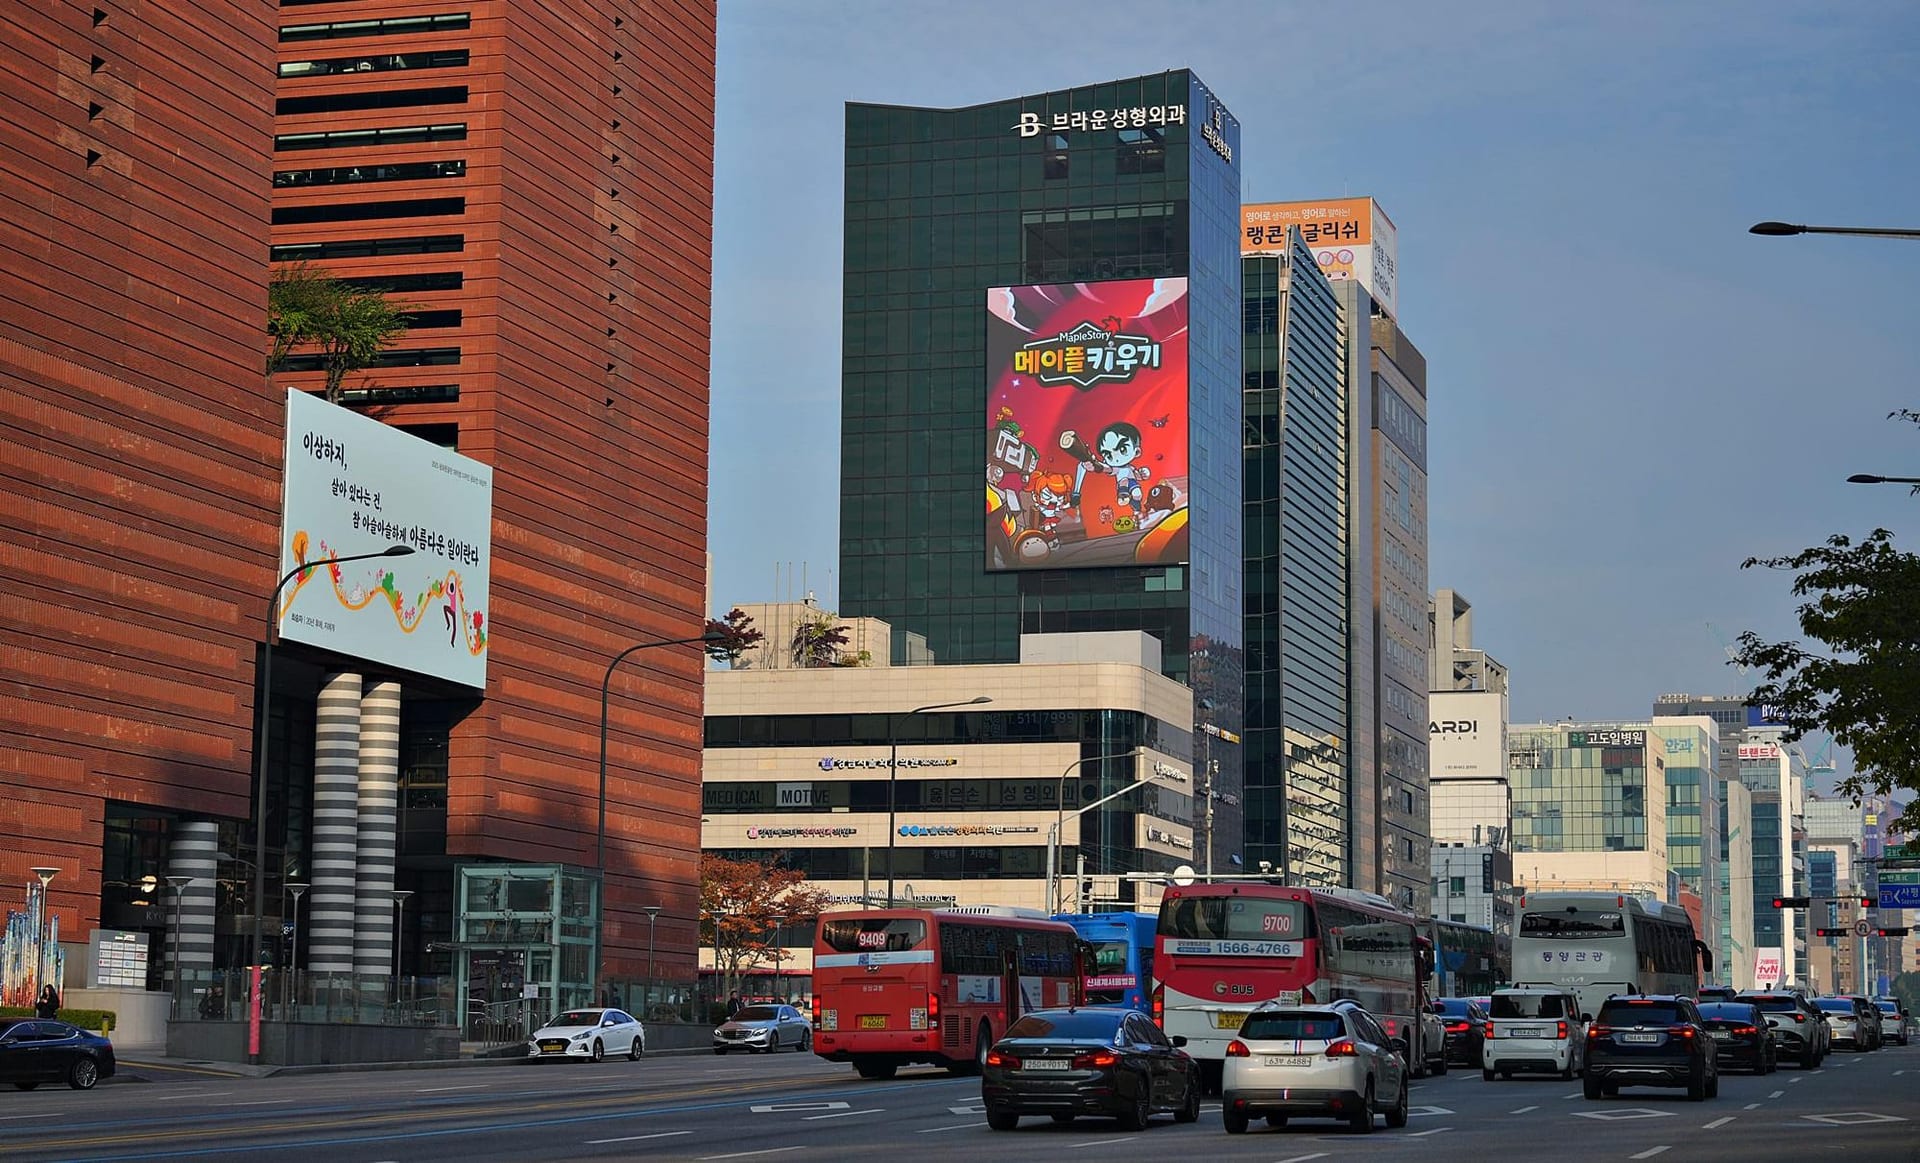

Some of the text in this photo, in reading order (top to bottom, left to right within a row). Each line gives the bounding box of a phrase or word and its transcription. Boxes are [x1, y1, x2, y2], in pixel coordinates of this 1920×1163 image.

[1052, 104, 1186, 131] 브라운성형외과
[1246, 210, 1272, 223] 영어로
[1302, 208, 1327, 220] 영어로
[1246, 220, 1359, 246] 랭콘글리쉬
[1060, 331, 1112, 344] MapleStory
[303, 430, 348, 471] 이상하지,
[331, 477, 383, 513] 살아 있다는 건,
[352, 511, 480, 567] 참 아슬아슬하게 아름다운 일이란다
[1586, 731, 1644, 746] 고도일병원
[1665, 737, 1694, 754] 안과
[706, 789, 830, 804] MEDICAL MOTIVE
[1264, 916, 1290, 932] 9700
[859, 932, 886, 946] 9409
[1216, 942, 1291, 955] 1566-4766
[1542, 951, 1603, 963] 동양관광
[1759, 965, 1778, 973] tvN
[1231, 984, 1255, 996] BUS
